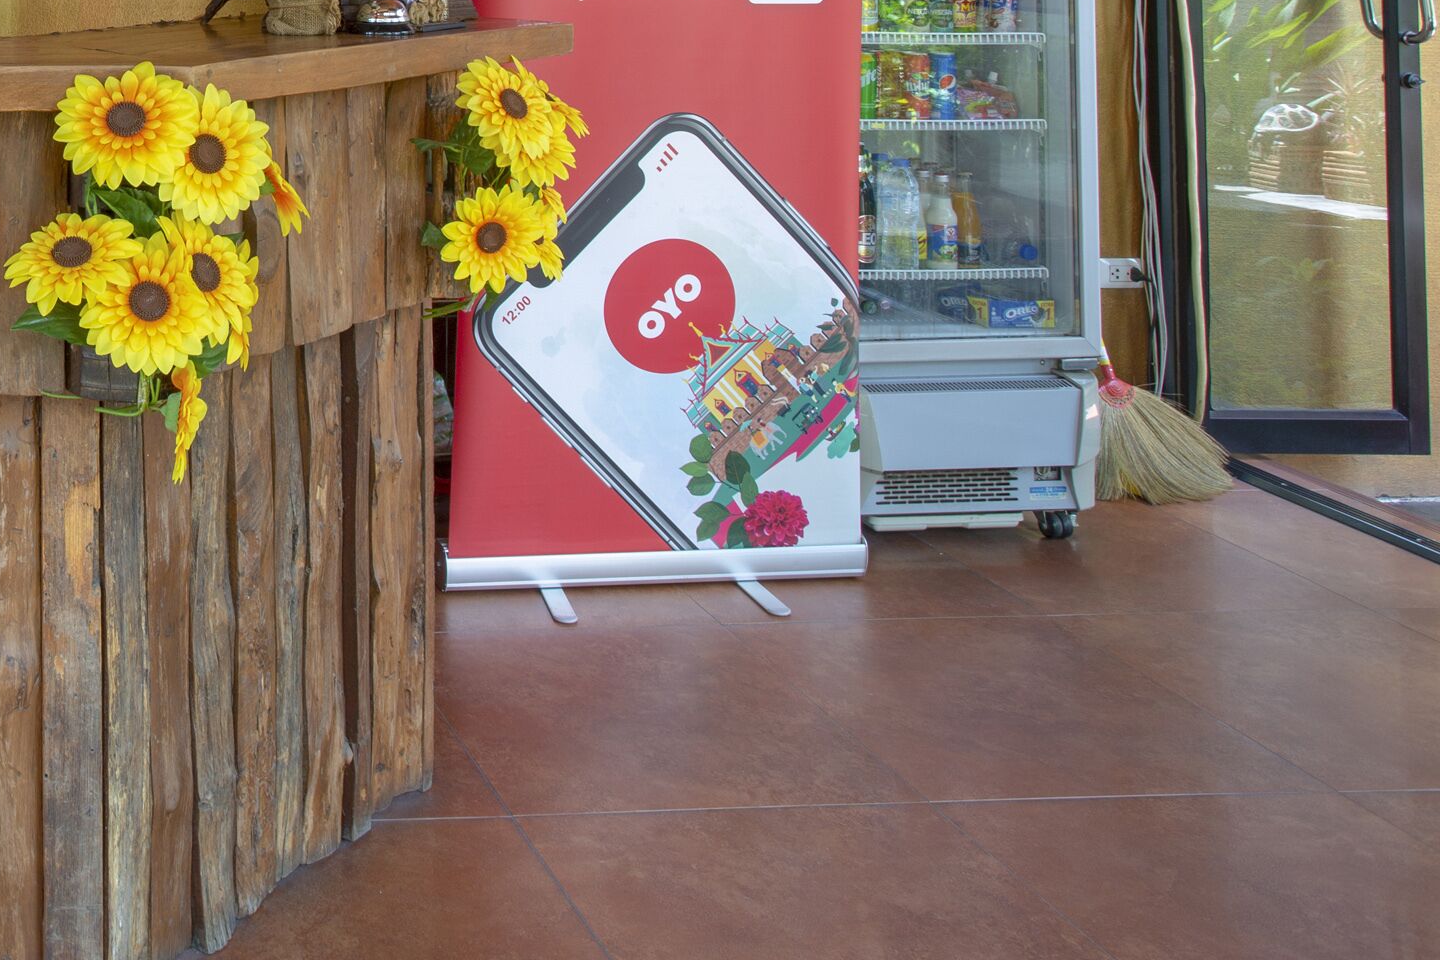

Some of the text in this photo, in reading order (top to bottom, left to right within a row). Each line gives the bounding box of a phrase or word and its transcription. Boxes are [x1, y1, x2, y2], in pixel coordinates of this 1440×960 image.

[501, 295, 532, 326] 12:00
[637, 274, 701, 339] OYO
[1005, 305, 1039, 319] OREO
